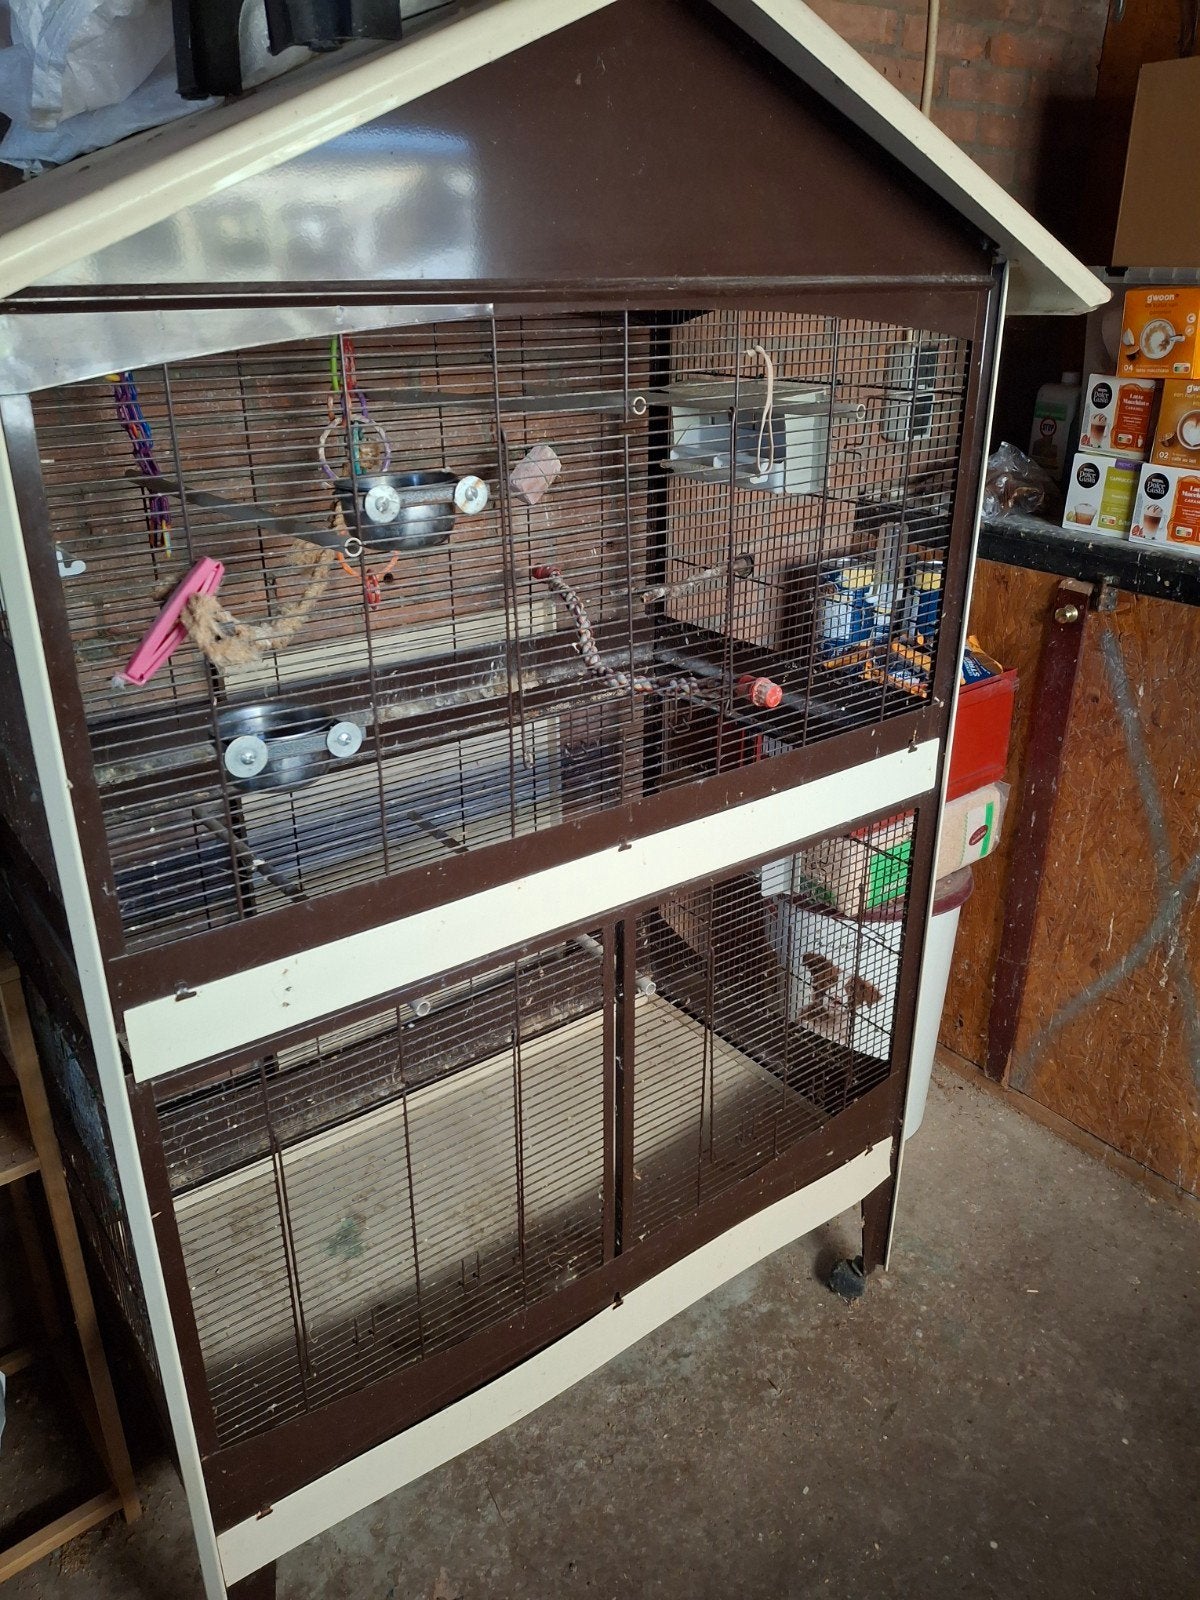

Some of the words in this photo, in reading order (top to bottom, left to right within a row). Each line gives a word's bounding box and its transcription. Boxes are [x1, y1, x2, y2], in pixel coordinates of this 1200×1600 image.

[1147, 294, 1175, 304] gwoon
[1094, 391, 1110, 399] Dolce
[1130, 393, 1144, 401] Latte
[1094, 396, 1109, 404] Gusto
[1123, 398, 1150, 406] Macchiato
[1159, 451, 1169, 459] 02
[1080, 470, 1096, 478] Dolce
[1079, 476, 1096, 484] Gusto
[1147, 482, 1166, 490] Dolce
[1147, 487, 1165, 495] Gusto
